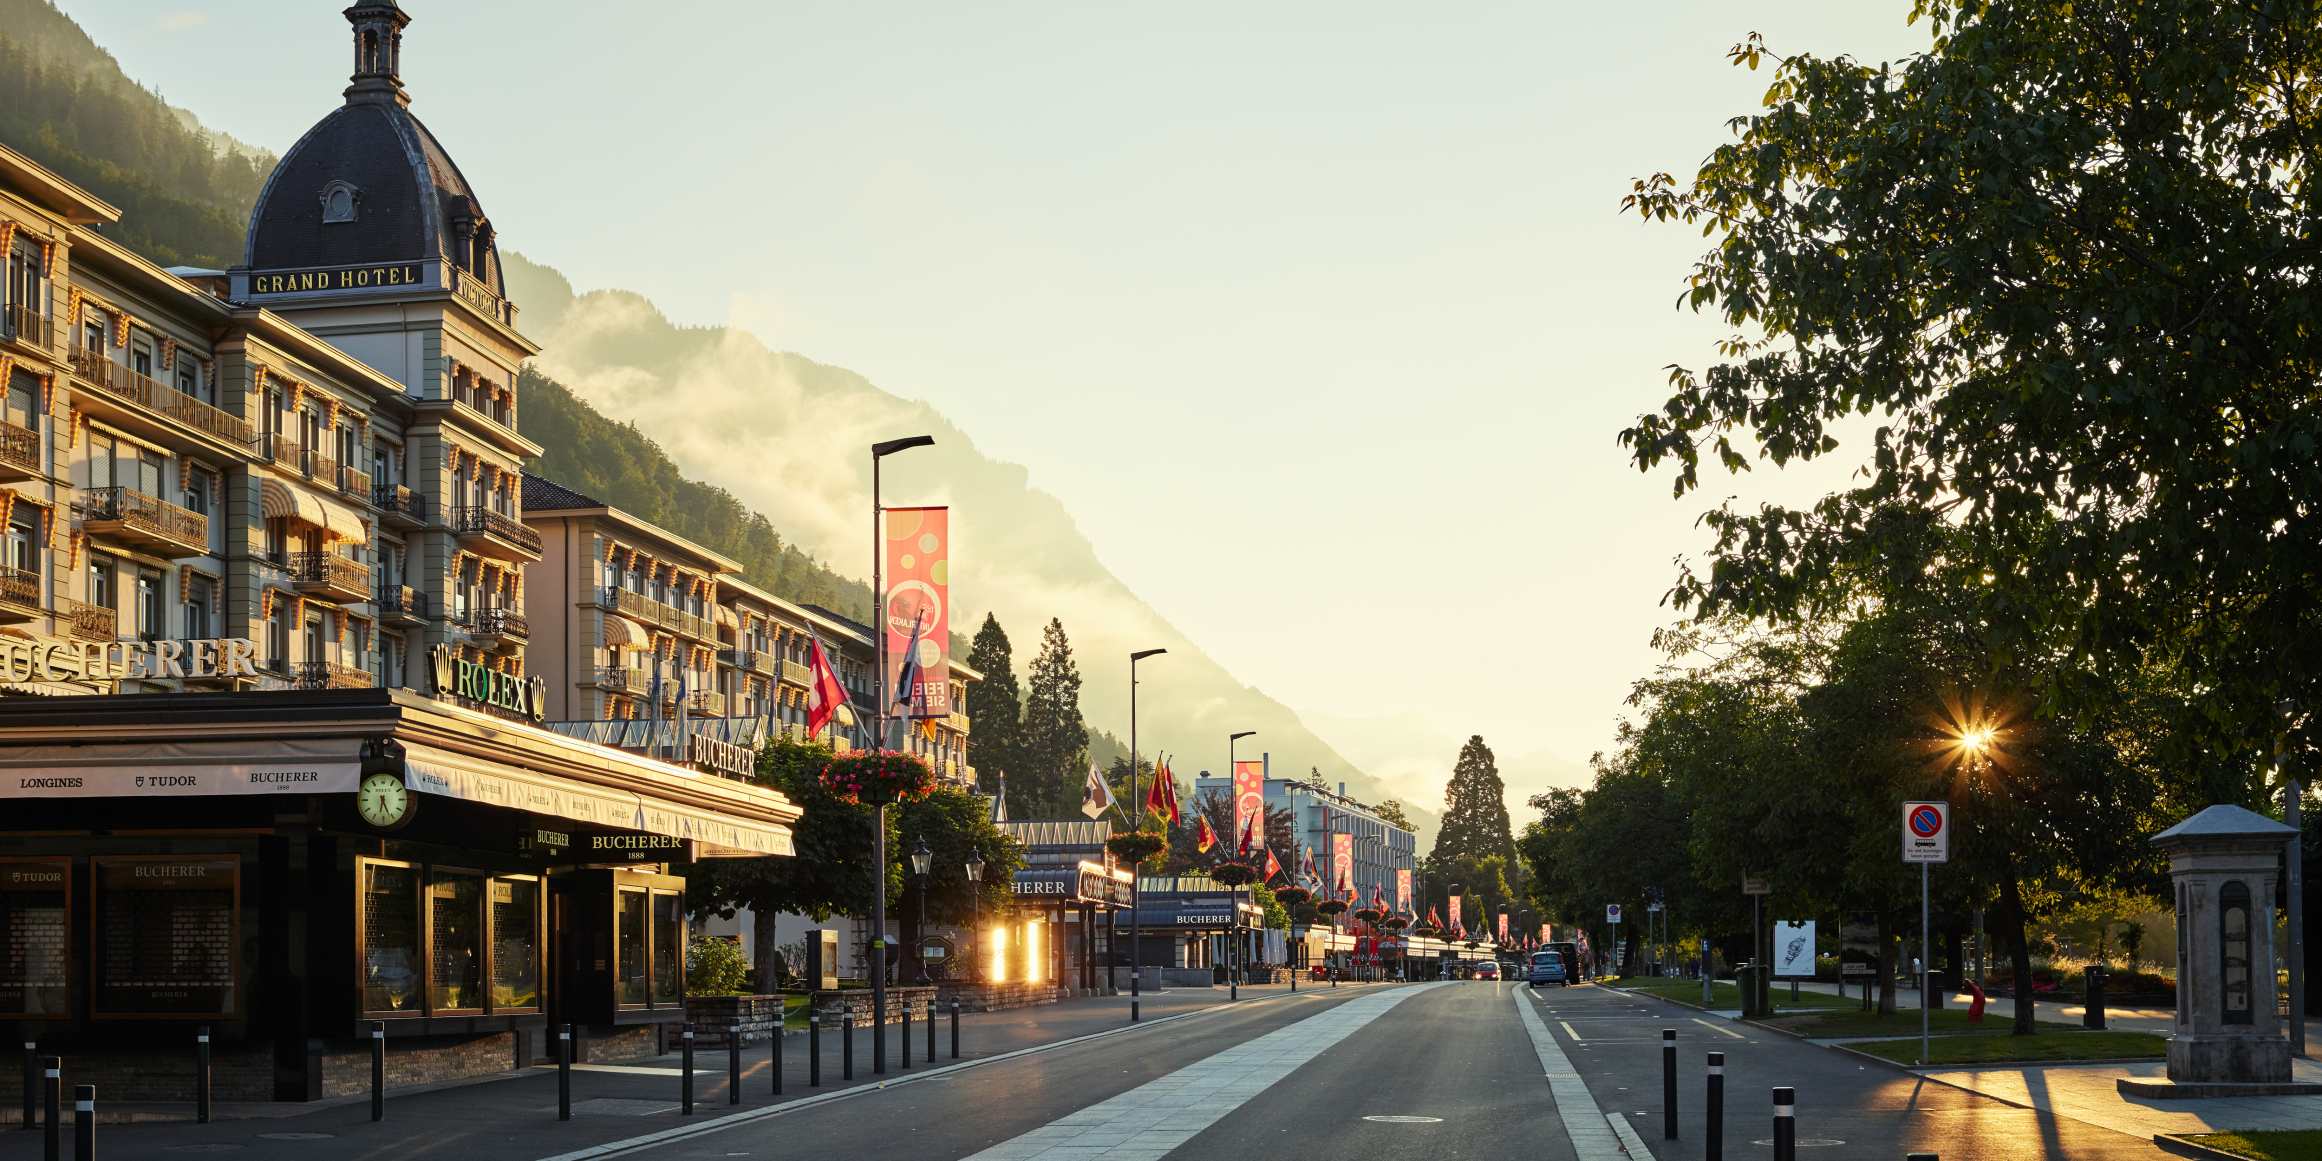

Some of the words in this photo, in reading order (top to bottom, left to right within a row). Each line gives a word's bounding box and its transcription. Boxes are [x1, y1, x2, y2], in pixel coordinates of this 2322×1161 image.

[256, 272, 329, 293] GRAND
[340, 266, 415, 288] HOTEL
[457, 657, 528, 714] ROLEX
[694, 733, 756, 777] BUCHERER
[20, 777, 83, 788] LONGINES
[149, 775, 197, 787] TUDOR
[250, 771, 318, 784] BUCHERER
[537, 829, 569, 847] BUCHERER
[592, 835, 682, 849] BUCHERER
[628, 851, 645, 860] 1888
[22, 872, 62, 882] TUDOR
[135, 865, 206, 877] BUCHERER
[1176, 915, 1231, 924] BUCHERER
